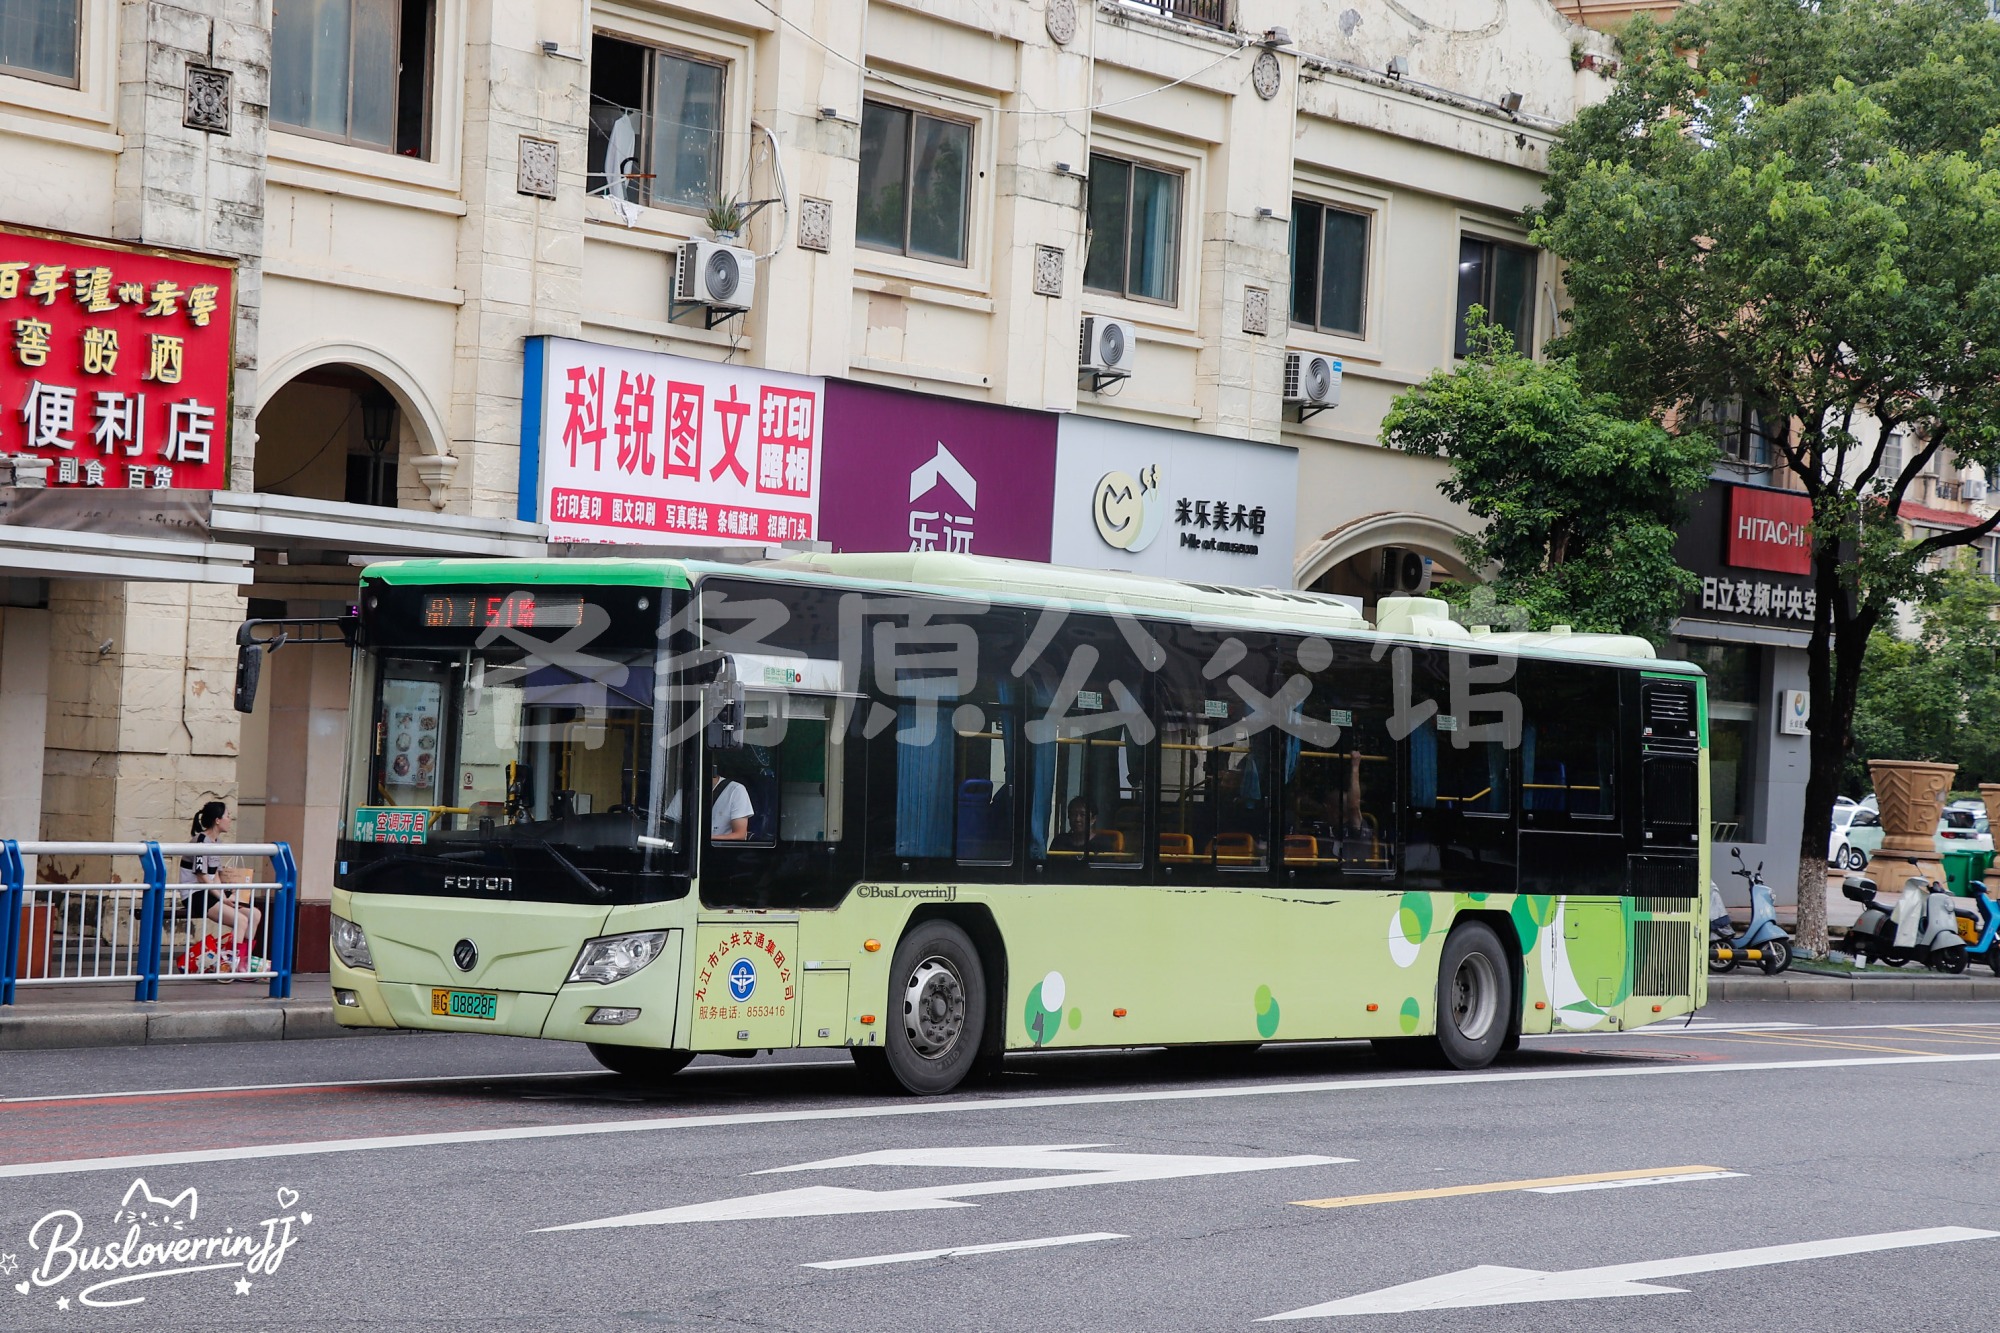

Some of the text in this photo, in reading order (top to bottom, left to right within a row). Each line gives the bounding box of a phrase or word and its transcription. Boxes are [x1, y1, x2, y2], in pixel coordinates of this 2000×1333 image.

[15, 317, 184, 384] 窖龄酒
[0, 380, 215, 464] 便利店
[562, 365, 750, 487] 科锐图文
[762, 391, 812, 441] 打印
[59, 456, 174, 489] 副食 百货
[759, 442, 810, 493] 照相
[556, 492, 807, 540] 打印复印 图文印刷 写真喷绘 条幅旗帜 招牌门头
[1175, 497, 1266, 535] 米乐美术馆
[1738, 516, 1804, 547] HITACHI
[1702, 576, 1835, 624] 日立变频中央空
[376, 812, 425, 833] 空调开启
[444, 875, 513, 892] FOTON
[695, 929, 794, 1002] 九江市公共交通集团公司
[452, 994, 496, 1016] 08828F
